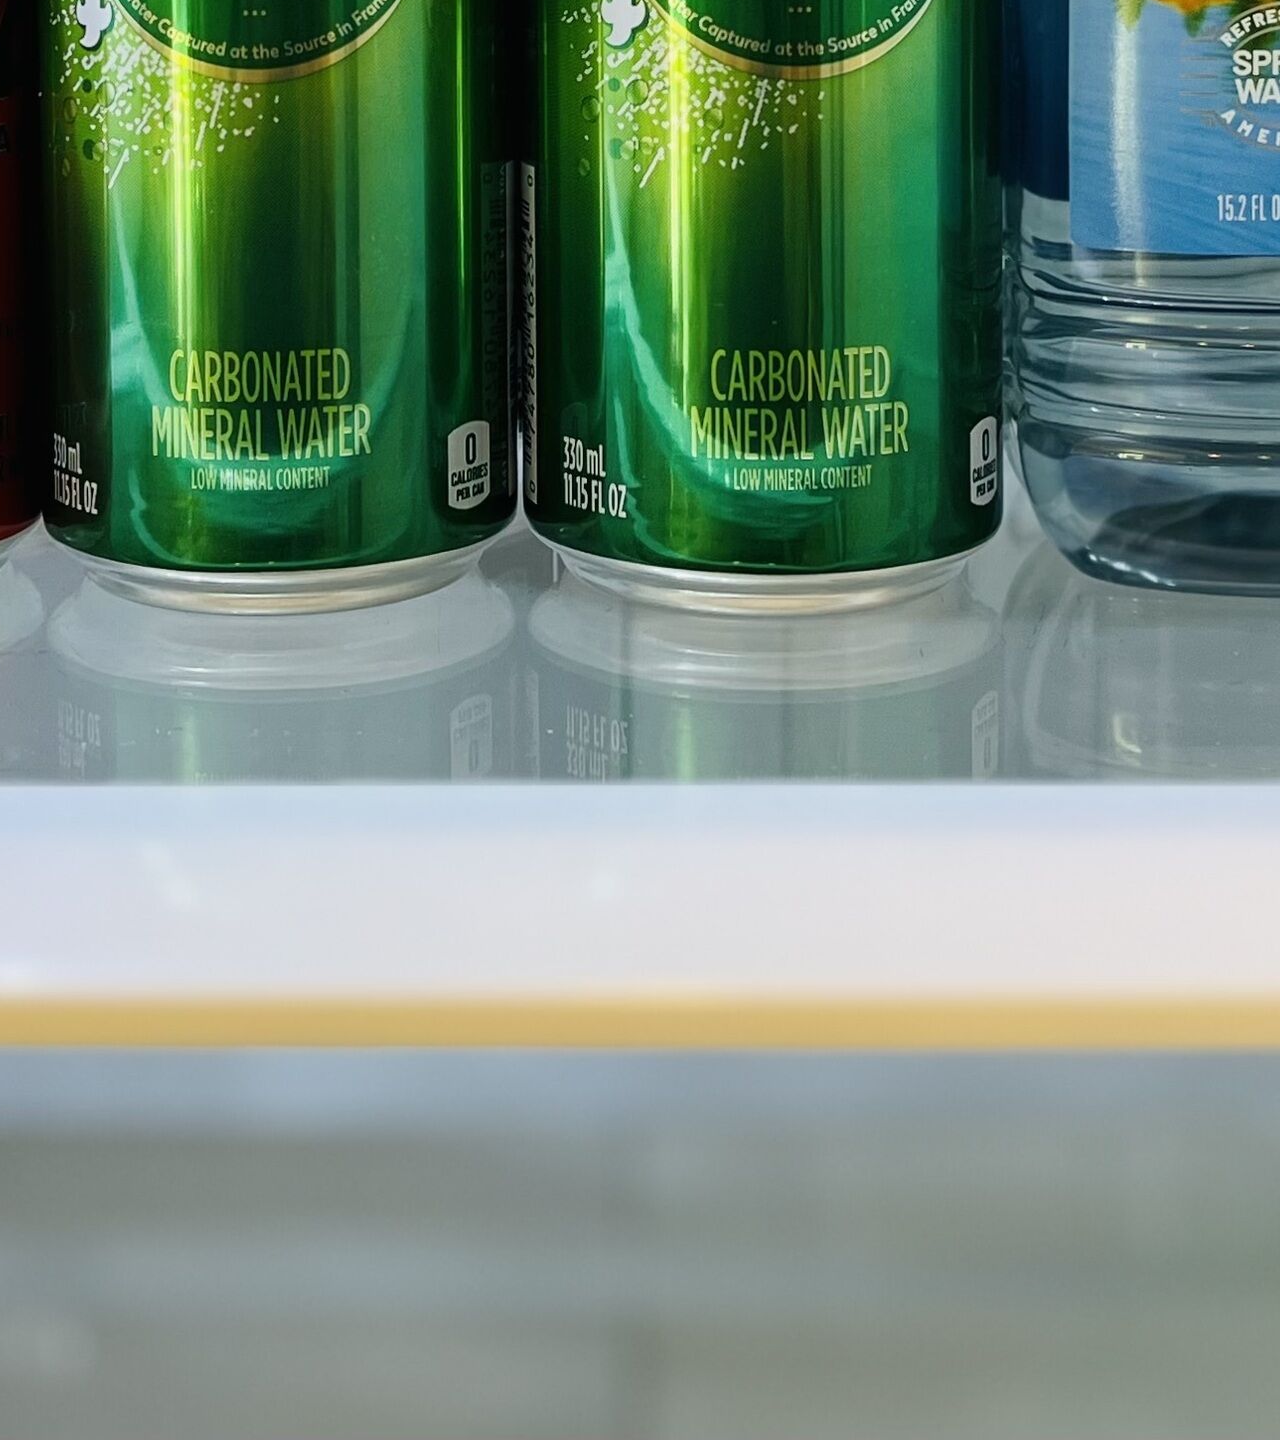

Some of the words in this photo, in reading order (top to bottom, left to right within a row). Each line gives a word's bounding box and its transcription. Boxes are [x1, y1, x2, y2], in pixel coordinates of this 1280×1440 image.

[157, 17, 227, 57] Captured
[230, 44, 248, 60] at
[252, 43, 280, 60] the
[284, 30, 337, 57] Source
[337, 20, 353, 38] in
[698, 15, 770, 54] Captured
[774, 41, 793, 57] at
[796, 41, 824, 57] the
[827, 26, 878, 53] Source
[877, 17, 893, 35] in
[1217, 194, 1247, 222] 15.2
[1251, 194, 1266, 222] FL
[169, 347, 351, 404] CARBONATED
[710, 345, 891, 403] CARBONATED
[152, 404, 269, 462] MINERAL
[276, 402, 371, 458] WATER
[465, 432, 476, 465] 0
[690, 403, 815, 462] MINERAL
[821, 400, 909, 458] WATER
[982, 428, 989, 461] 0
[54, 432, 66, 468] 330
[68, 442, 82, 475] mL
[451, 462, 488, 487] CALORIES
[562, 435, 586, 472] 330
[587, 443, 607, 478] mL
[71, 476, 82, 510] FL
[84, 480, 98, 515] OZ
[191, 466, 217, 490] LOW
[220, 467, 273, 491] MINERAL
[276, 466, 331, 490] CONTENT
[456, 486, 470, 502] PER
[563, 472, 588, 510] 11.15
[590, 480, 606, 515] FL
[608, 484, 628, 519] OZ
[733, 467, 761, 491] LOW
[764, 467, 818, 491] MINERAL
[821, 464, 872, 489] CONTENT
